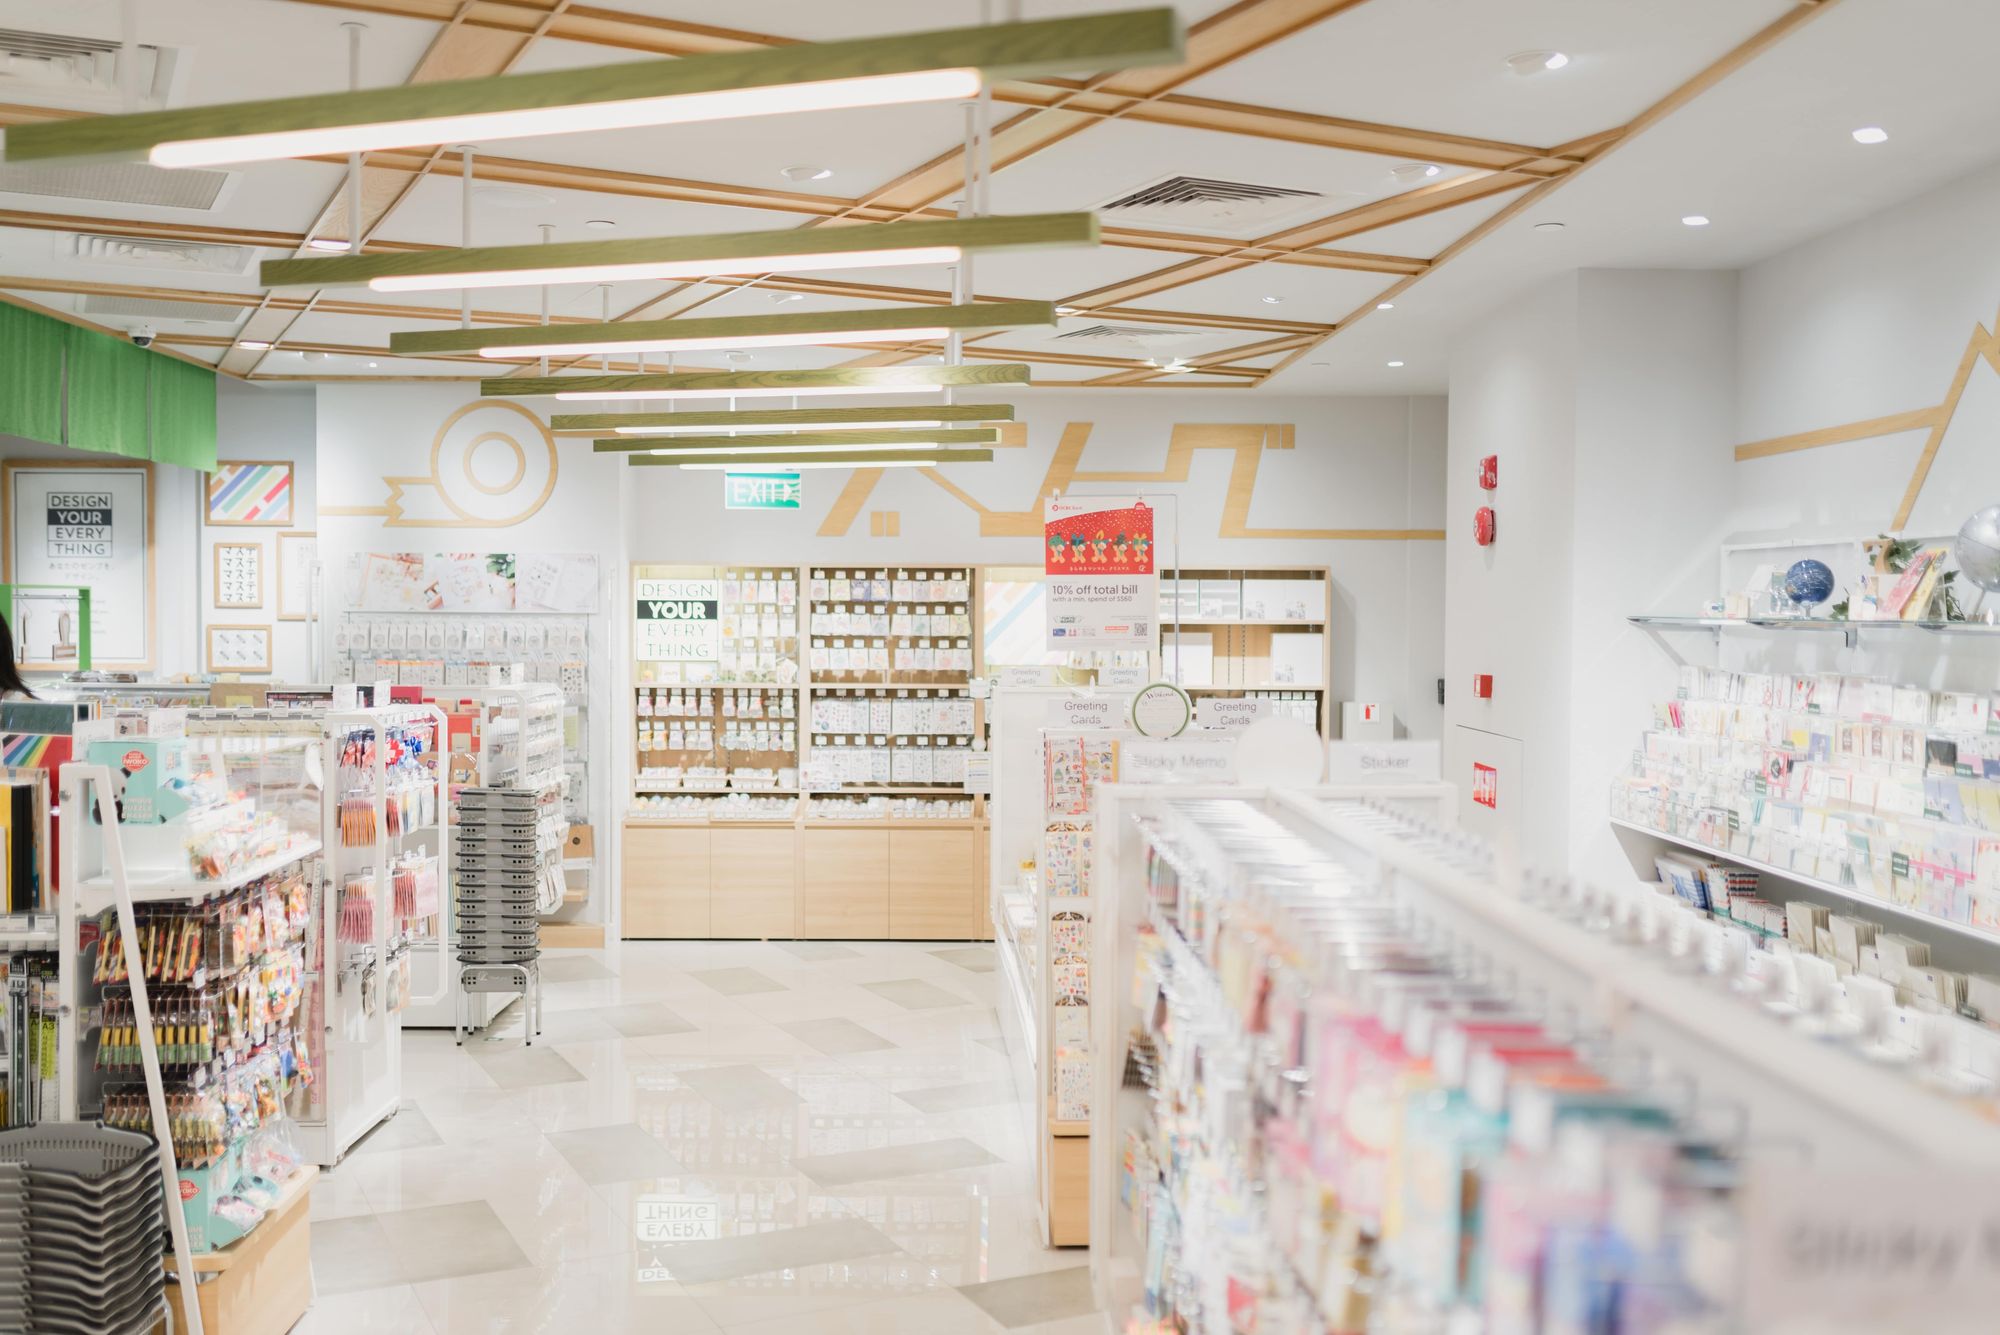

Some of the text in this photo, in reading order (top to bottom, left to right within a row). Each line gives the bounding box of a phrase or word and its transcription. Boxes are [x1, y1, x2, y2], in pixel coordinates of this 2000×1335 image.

[733, 480, 778, 503] EXIT
[51, 495, 109, 507] DESIGN
[57, 511, 103, 524] YOUR
[55, 527, 105, 539] EVERY
[55, 543, 105, 555] THING
[642, 583, 713, 597] DESIGN
[1053, 584, 1138, 594] 10% off total bill
[648, 601, 706, 619] YOUR
[647, 623, 708, 637] EVERY
[647, 643, 709, 657] THING
[1064, 701, 1108, 712] Greeting
[1214, 702, 1257, 713] Greeting
[1071, 715, 1101, 725] Cards
[1220, 715, 1250, 725] Cards
[1361, 755, 1409, 769] Sticker
[42, 1022, 55, 1030] A3
